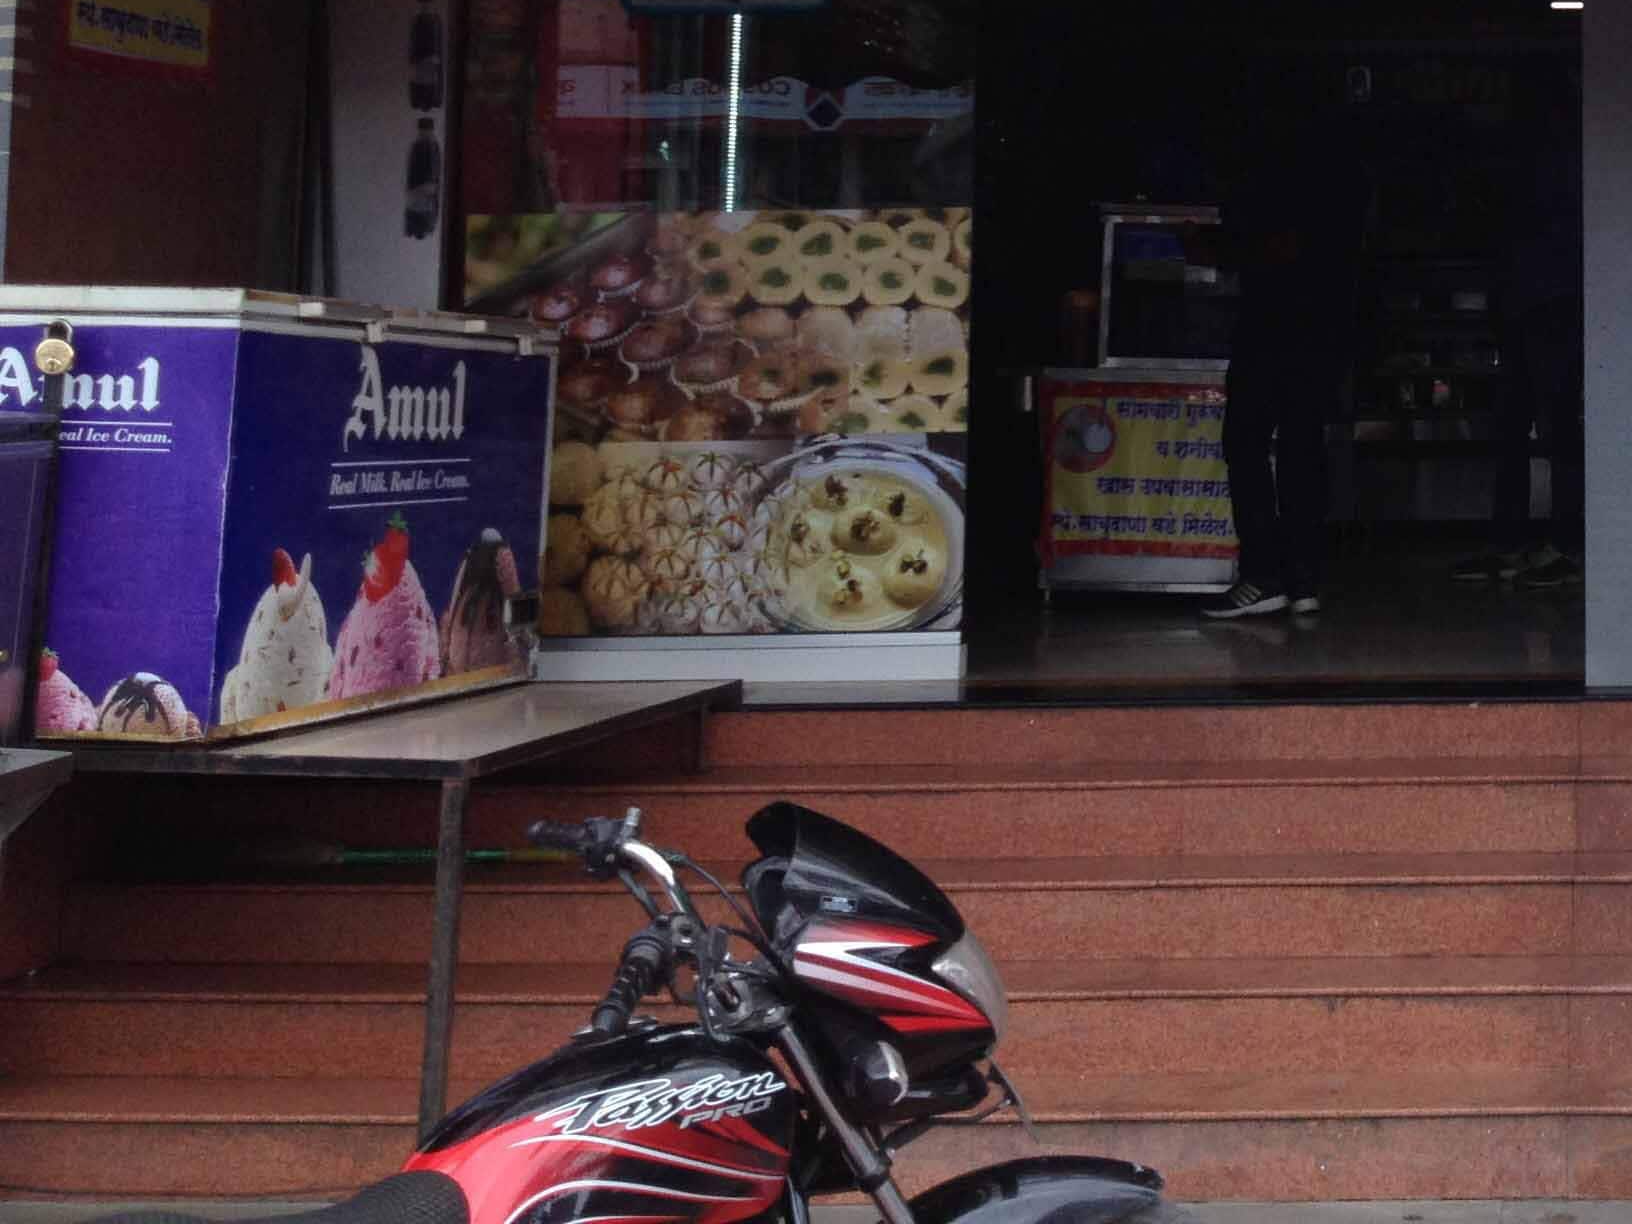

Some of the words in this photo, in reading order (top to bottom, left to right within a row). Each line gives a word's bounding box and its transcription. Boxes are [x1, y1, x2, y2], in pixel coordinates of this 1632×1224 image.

[342, 344, 467, 453] Amul
[58, 428, 83, 442] eal
[86, 429, 110, 443] Ice
[114, 429, 173, 444] Cream.
[533, 1072, 787, 1136] Passion
[680, 1096, 773, 1130] PRO
